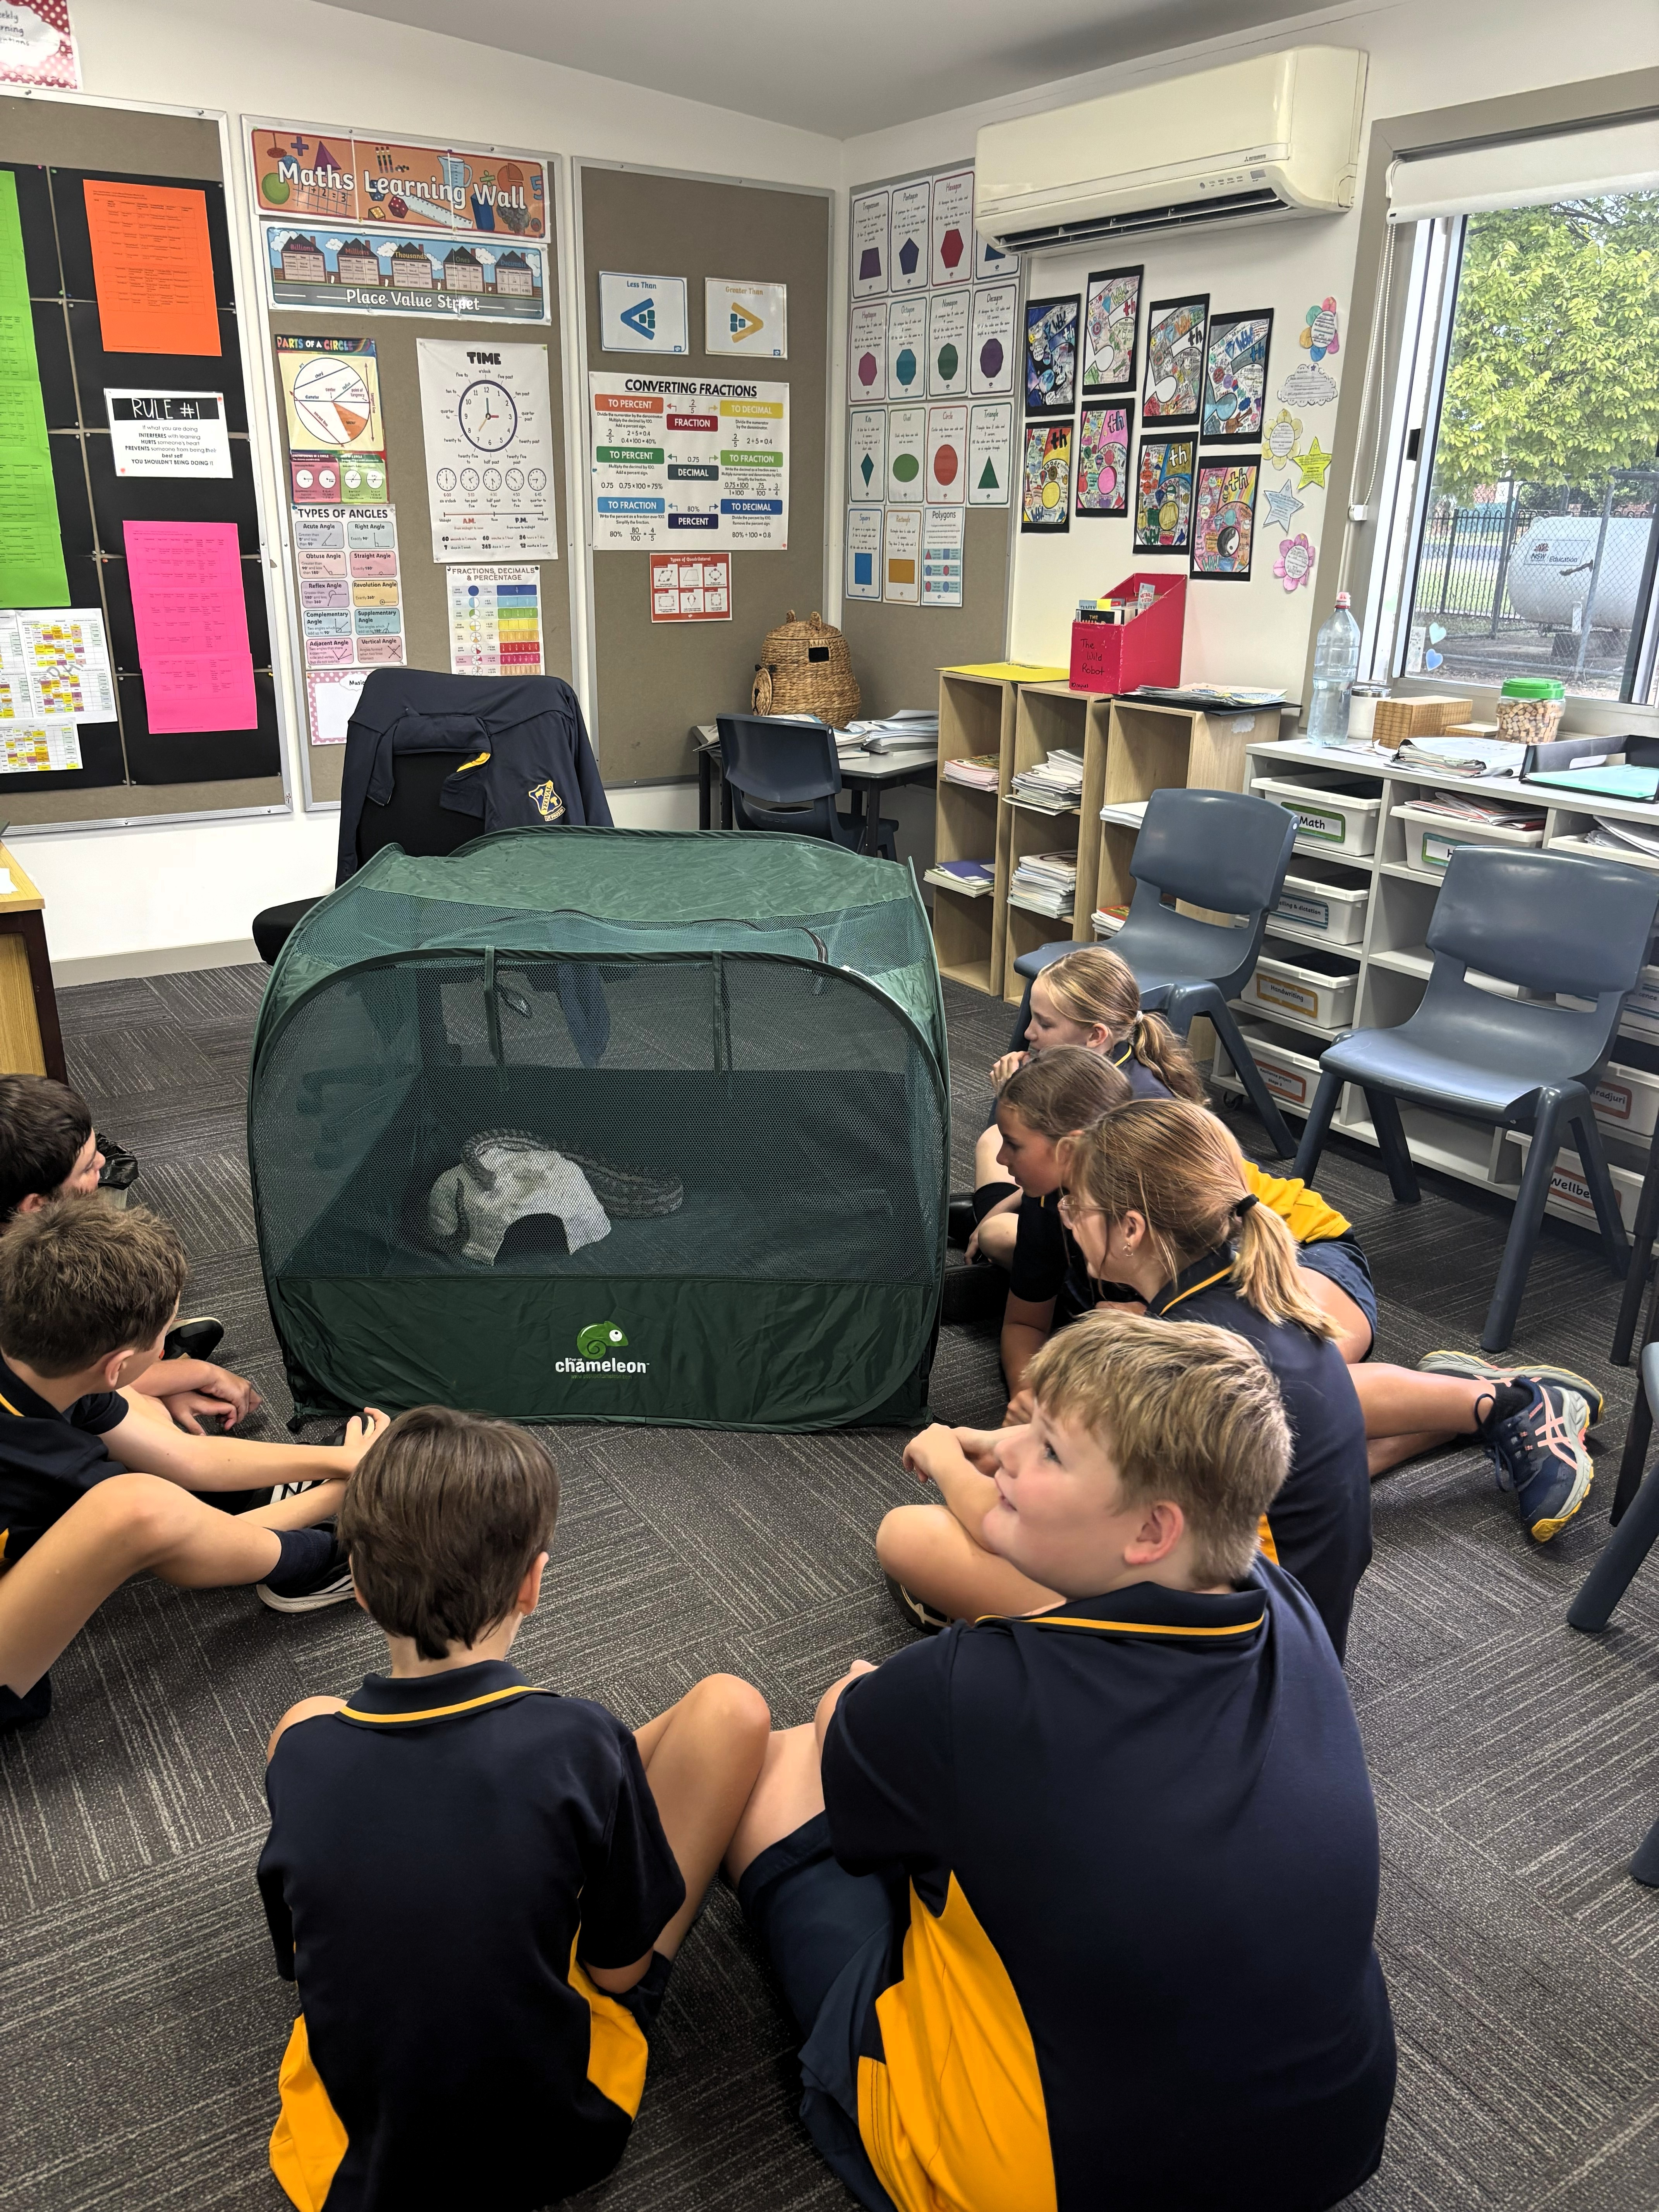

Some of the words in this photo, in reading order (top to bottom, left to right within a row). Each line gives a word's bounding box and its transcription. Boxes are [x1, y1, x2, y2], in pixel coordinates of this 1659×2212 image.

[278, 161, 354, 191] Maths
[364, 170, 466, 210] Learning
[474, 182, 526, 210] Wall
[946, 182, 962, 194] Hexagon
[903, 193, 918, 201] Pentagon
[395, 251, 427, 259] Thousands
[726, 287, 747, 295] Greater
[346, 289, 386, 305] Place
[390, 292, 432, 307] Value
[438, 294, 480, 310] Street
[987, 294, 1003, 305] Decagon
[901, 305, 915, 316] Octagon
[943, 299, 958, 312] Nonagon
[862, 311, 876, 320] Heptagon
[277, 337, 303, 349] PARTS
[324, 340, 353, 351] CIRCLE
[467, 352, 501, 365] TIME
[625, 379, 697, 394] CONVERTING
[699, 383, 757, 397] FRACTIONS
[132, 398, 173, 420] RULE
[180, 402, 200, 420] #1
[608, 399, 618, 407] TO
[620, 400, 652, 409] PERCENT
[742, 406, 772, 414] DECIMAL
[943, 411, 953, 420] Circle
[984, 409, 998, 421] Triangle
[675, 419, 710, 428] FRACTION
[622, 452, 653, 460] PERCENT
[678, 469, 709, 477] DECIMAL
[742, 503, 771, 511] DECIMAL
[297, 509, 329, 518] TYPES
[333, 509, 345, 518] OF
[349, 509, 388, 518] ANGLES
[859, 514, 871, 524] Square
[932, 510, 956, 520] Polygons
[678, 517, 709, 526] PERCENT
[896, 515, 910, 526] Rectangle
[1080, 639, 1094, 649] The
[1087, 652, 1102, 661] Wild
[1082, 663, 1104, 675] Robot
[542, 786, 552, 811] YEOVAL
[1299, 816, 1325, 830] Math
[1298, 906, 1321, 915] dictation
[1271, 985, 1304, 1003] Handwriting
[1593, 1090, 1625, 1104] iradjuri
[1551, 1178, 1590, 1198] Wellbe
[555, 1357, 646, 1373] chameleon
